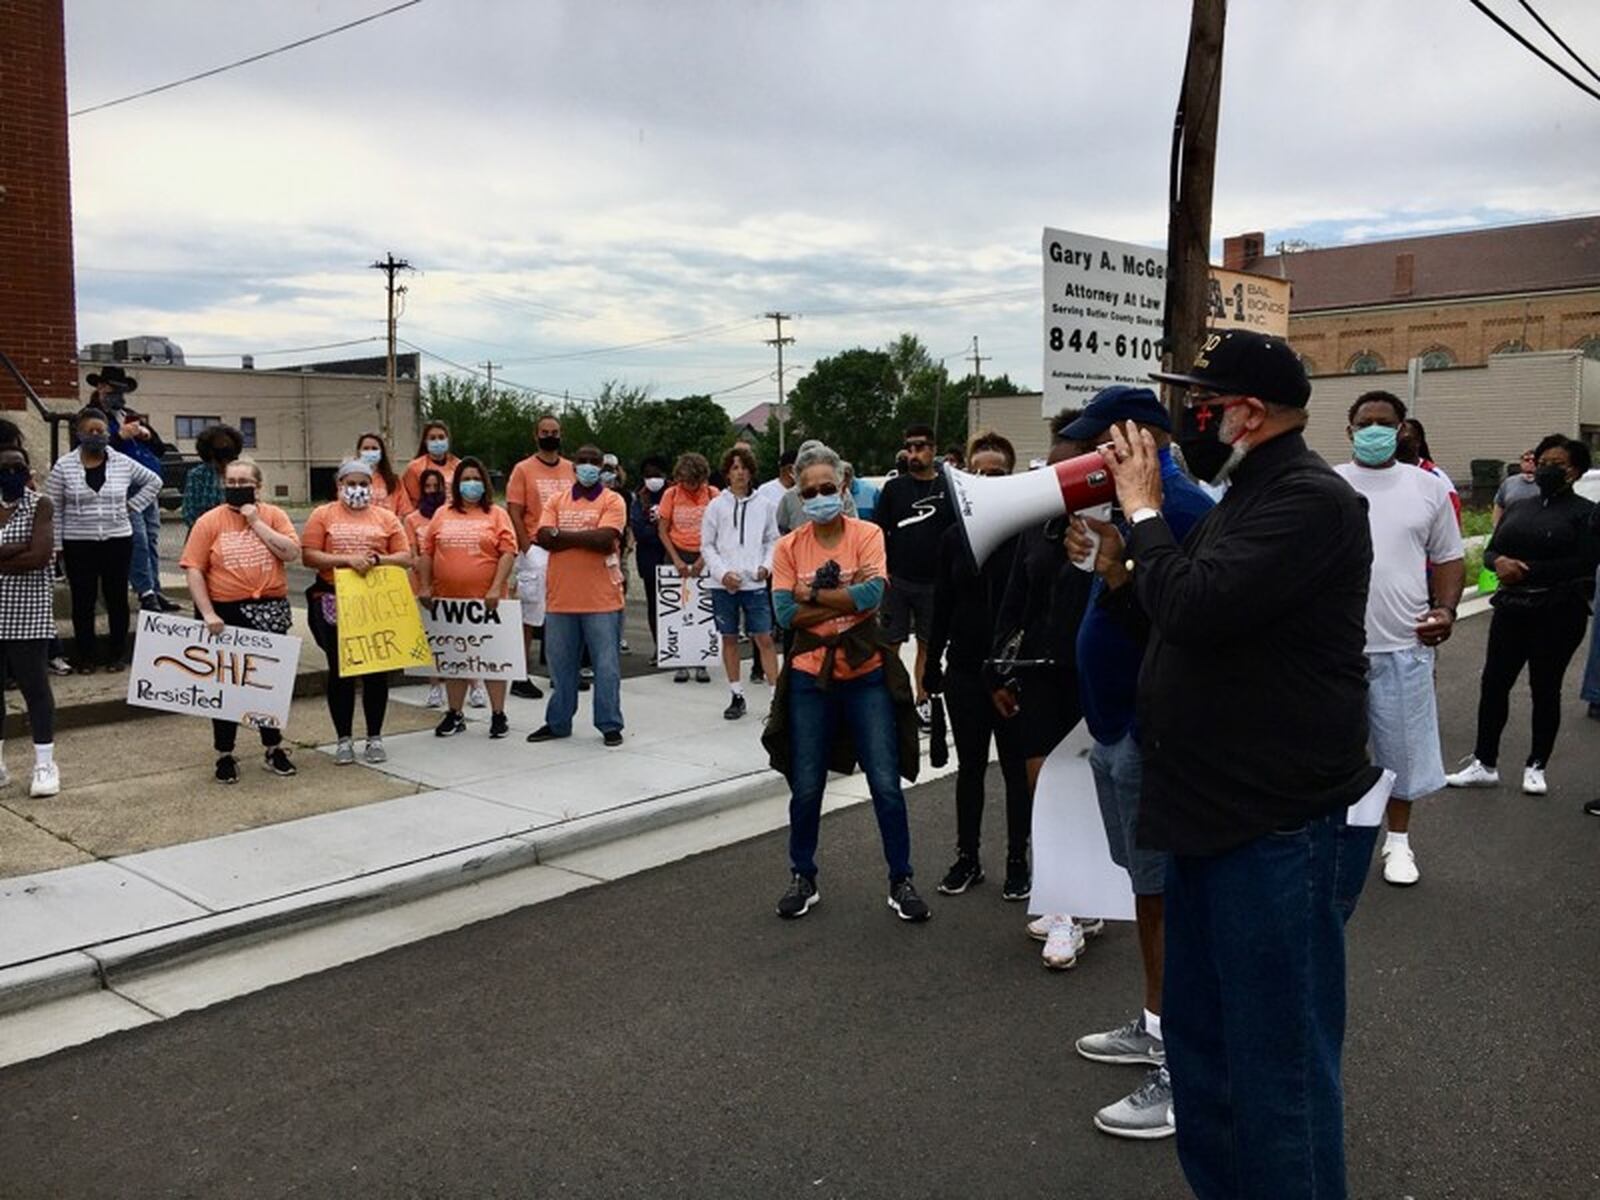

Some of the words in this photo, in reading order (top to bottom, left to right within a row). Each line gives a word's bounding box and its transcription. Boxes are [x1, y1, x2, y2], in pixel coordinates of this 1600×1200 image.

[1049, 241, 1092, 272] Gary
[1100, 250, 1116, 272] A.
[1123, 253, 1167, 279] McGe
[1065, 282, 1119, 307] Attorney
[1123, 291, 1137, 307] At
[1140, 293, 1161, 311] Law
[1206, 279, 1246, 322] A-1
[1247, 283, 1272, 299] BAIL
[1051, 303, 1085, 318] Serving
[1086, 307, 1110, 319] Butler
[1110, 310, 1135, 325] County
[1247, 298, 1287, 315] BONDS
[658, 568, 682, 617] VOTE
[429, 599, 502, 625] YWCA
[424, 631, 494, 653] ronger
[659, 625, 681, 662] Your
[700, 628, 720, 661] Your
[153, 645, 281, 692] SHE
[432, 650, 513, 675] Together
[136, 679, 224, 710] Persisted
